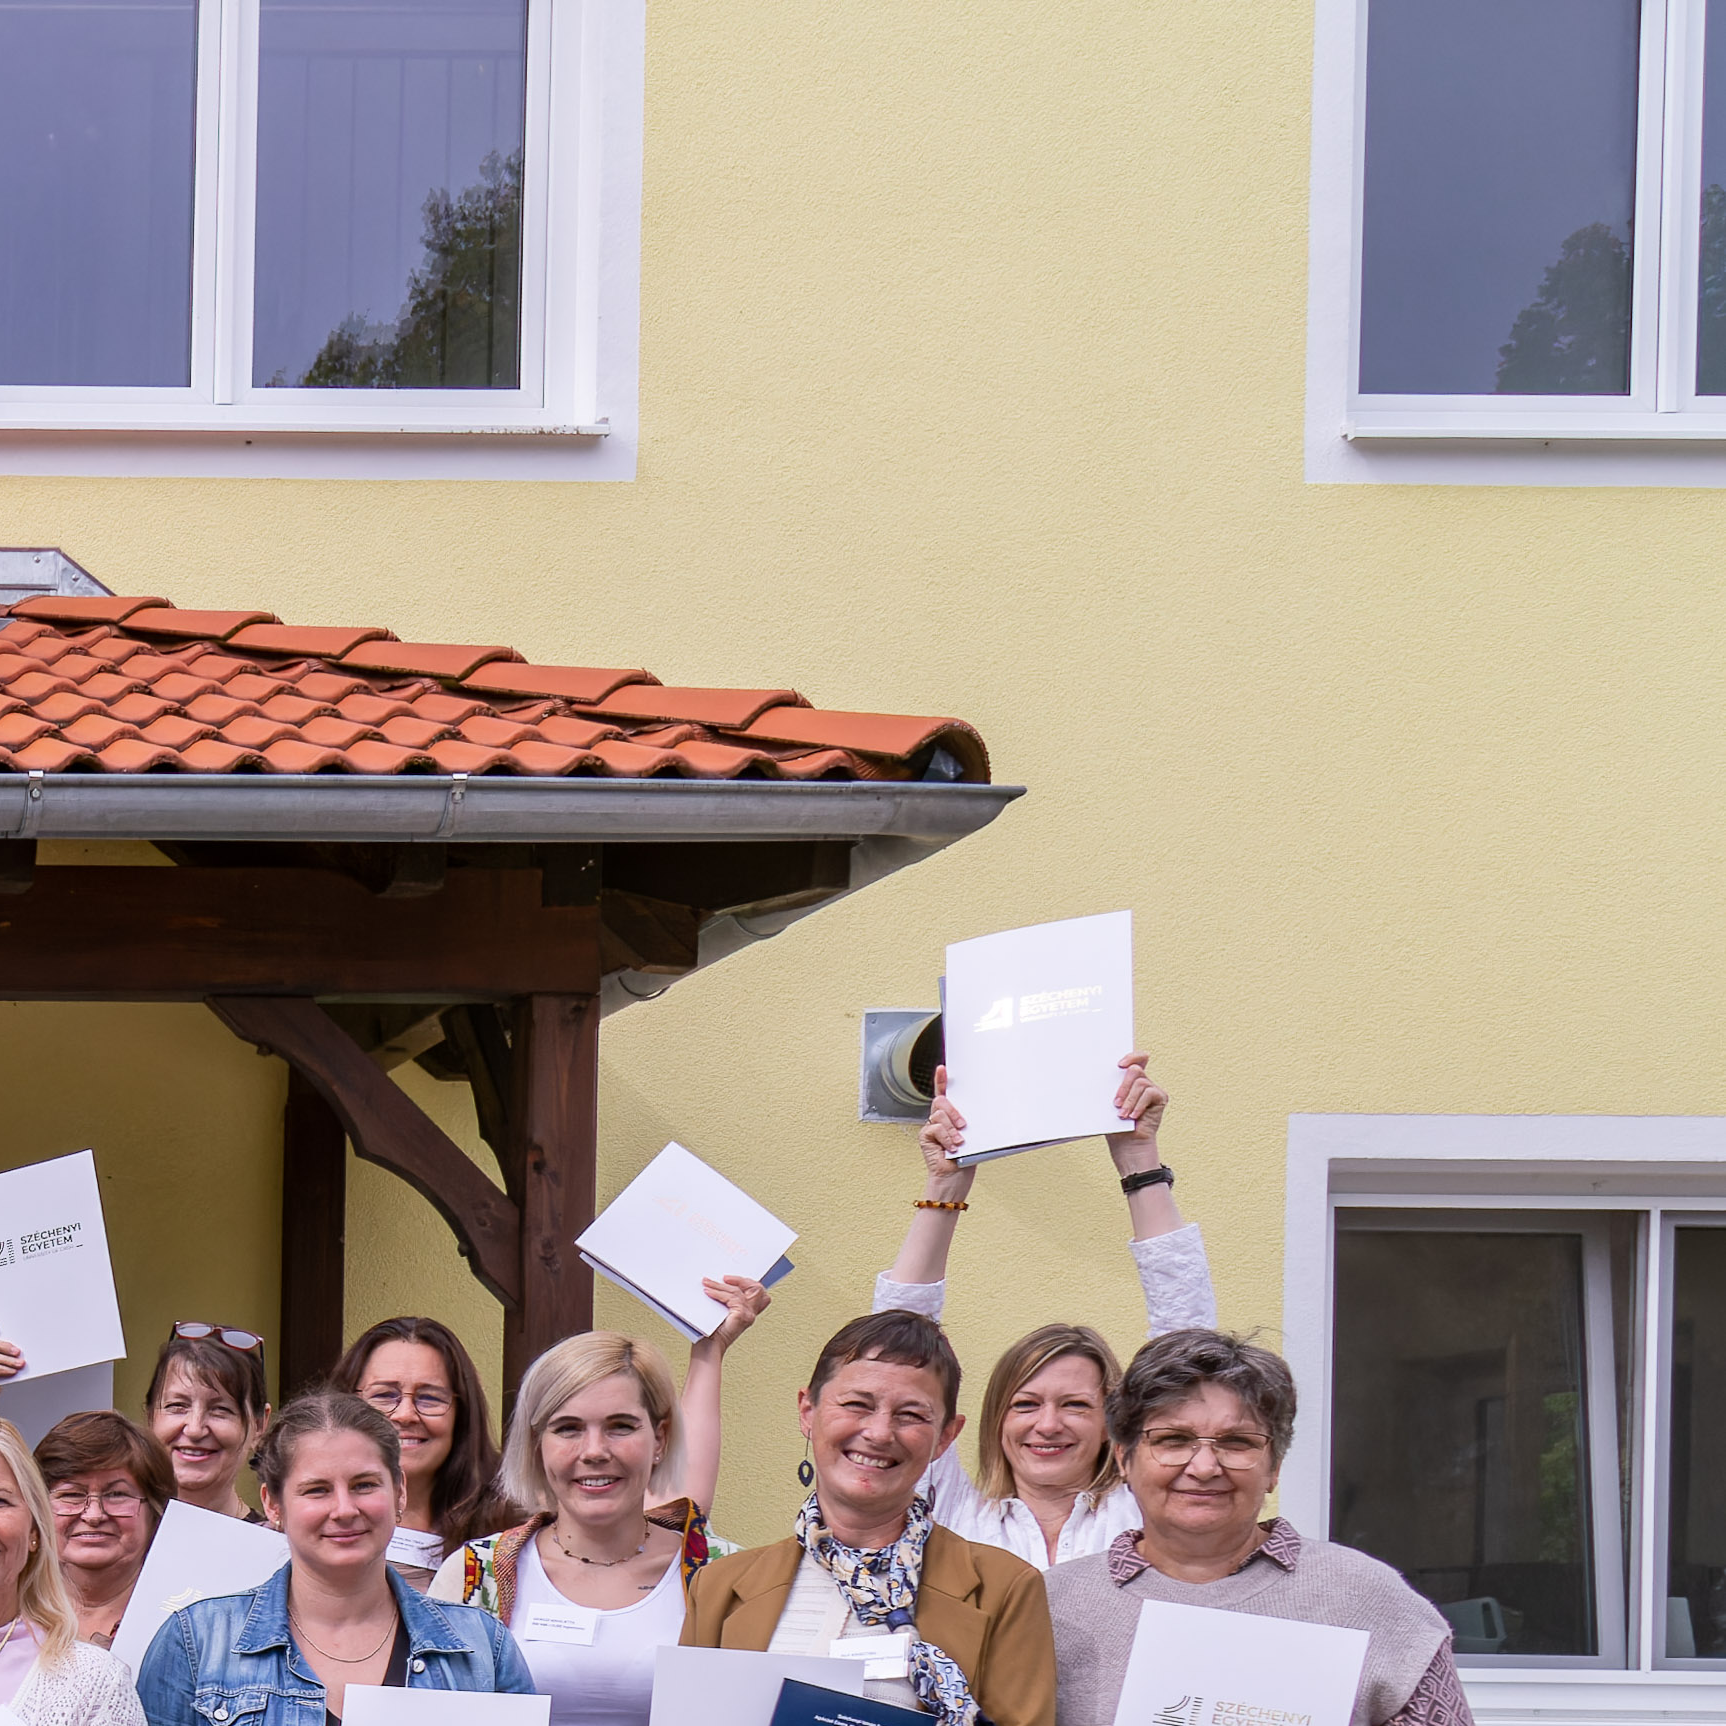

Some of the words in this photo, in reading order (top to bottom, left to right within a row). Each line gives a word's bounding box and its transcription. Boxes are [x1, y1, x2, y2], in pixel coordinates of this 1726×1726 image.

[20, 1222, 81, 1245] SZÉCHENYI
[21, 1235, 73, 1254] EGYETEM
[1215, 1700, 1311, 1726] SZÉCHENYI
